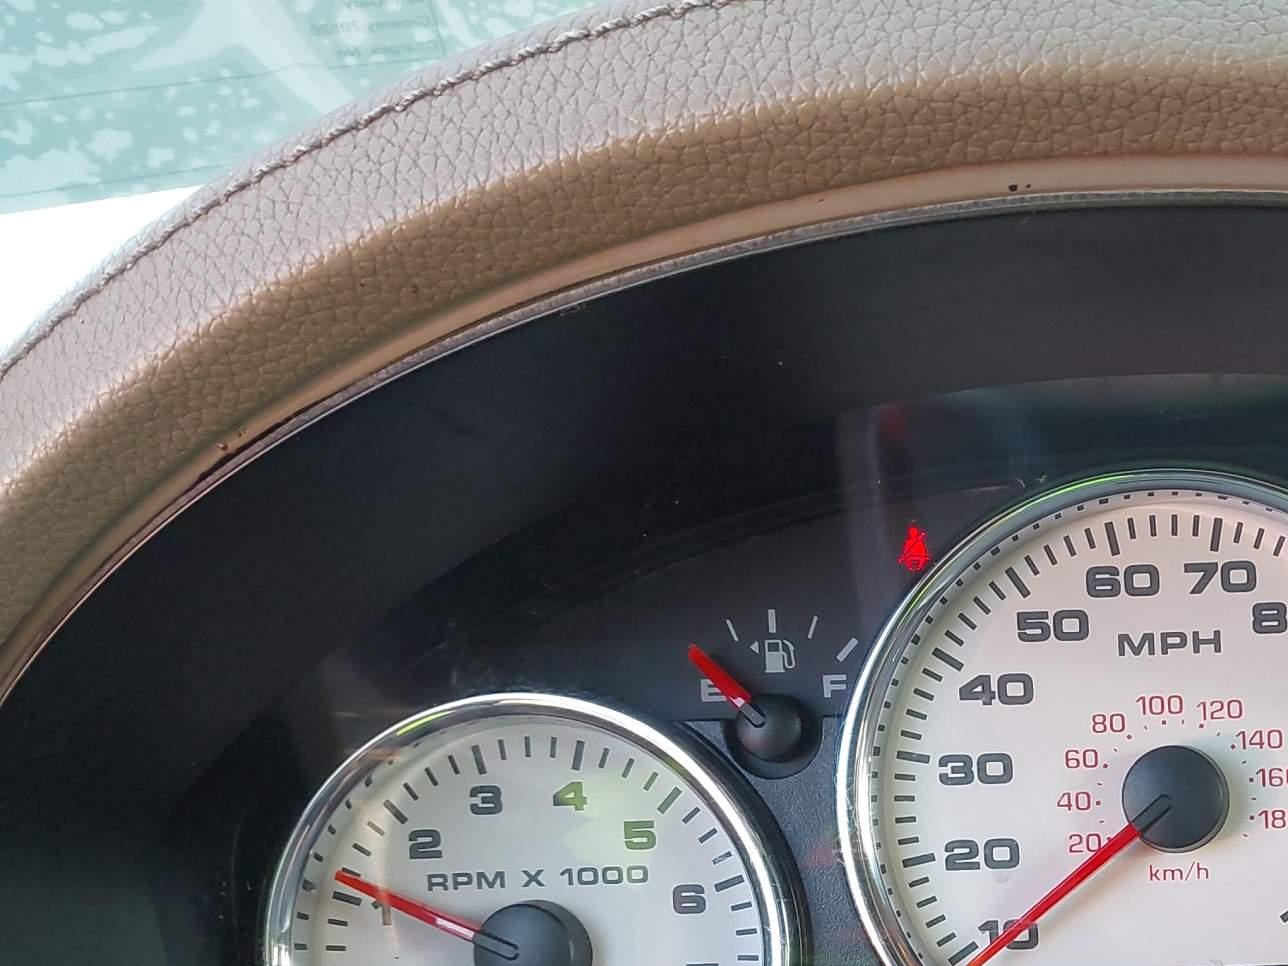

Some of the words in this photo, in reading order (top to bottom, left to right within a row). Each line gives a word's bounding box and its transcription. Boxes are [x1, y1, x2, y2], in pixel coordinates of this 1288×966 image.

[1086, 564, 1160, 598] 60
[1184, 560, 1257, 594] 70
[1016, 609, 1090, 643] 50
[1117, 630, 1222, 657] MPH
[822, 674, 847, 698] F
[958, 673, 1034, 706] 40
[1135, 694, 1184, 715] 100
[1196, 699, 1243, 720] 120
[1091, 713, 1126, 733] 80
[1235, 729, 1284, 749] 140
[938, 752, 1013, 786] 30
[1065, 748, 1099, 769] 60
[470, 785, 503, 816] 3
[552, 781, 588, 812] 4
[1057, 791, 1091, 811] 40
[408, 829, 443, 860] 2
[623, 820, 657, 851] 5
[1068, 833, 1102, 853] 20
[944, 838, 1020, 871] 20
[427, 871, 506, 891] RPM
[522, 869, 546, 887] X
[560, 865, 649, 886] 1000
[1149, 862, 1210, 881] km/h
[672, 884, 706, 914] 6
[978, 919, 1039, 950] 10
